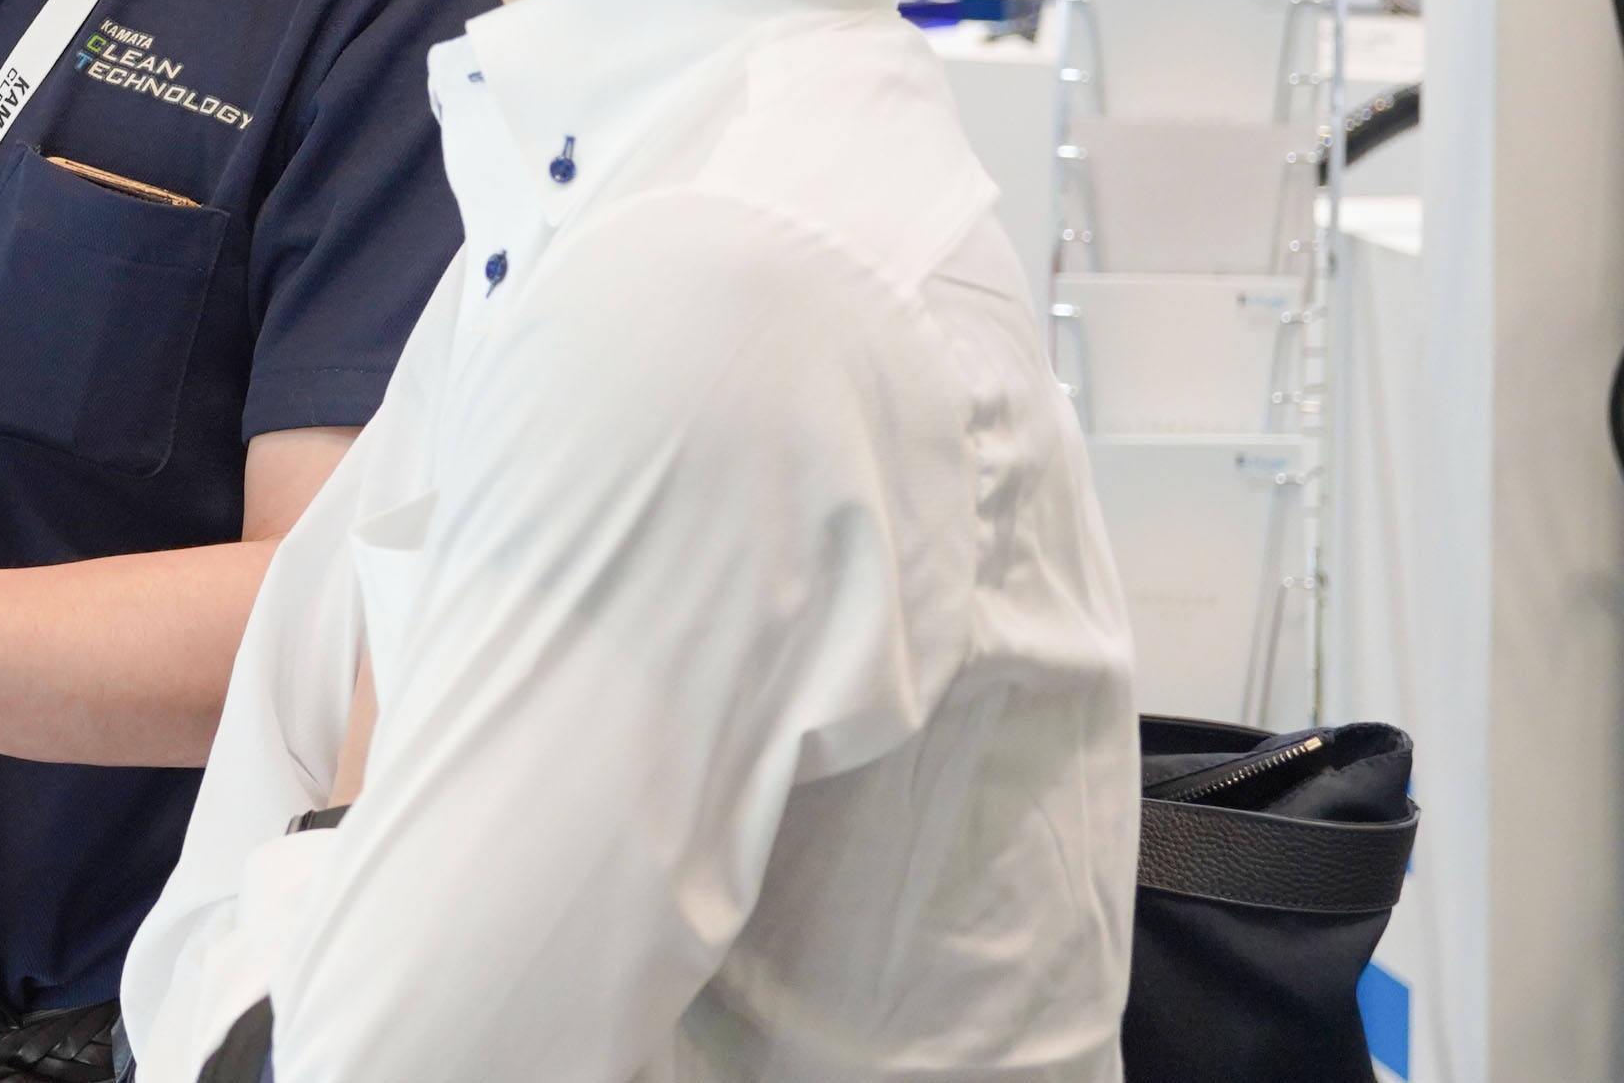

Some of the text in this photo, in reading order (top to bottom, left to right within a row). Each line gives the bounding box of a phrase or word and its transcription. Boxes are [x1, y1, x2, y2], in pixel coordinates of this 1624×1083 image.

[86, 34, 183, 79] CLEAN
[100, 19, 154, 50] KAMATA
[76, 51, 254, 130] TECHNOLOGY
